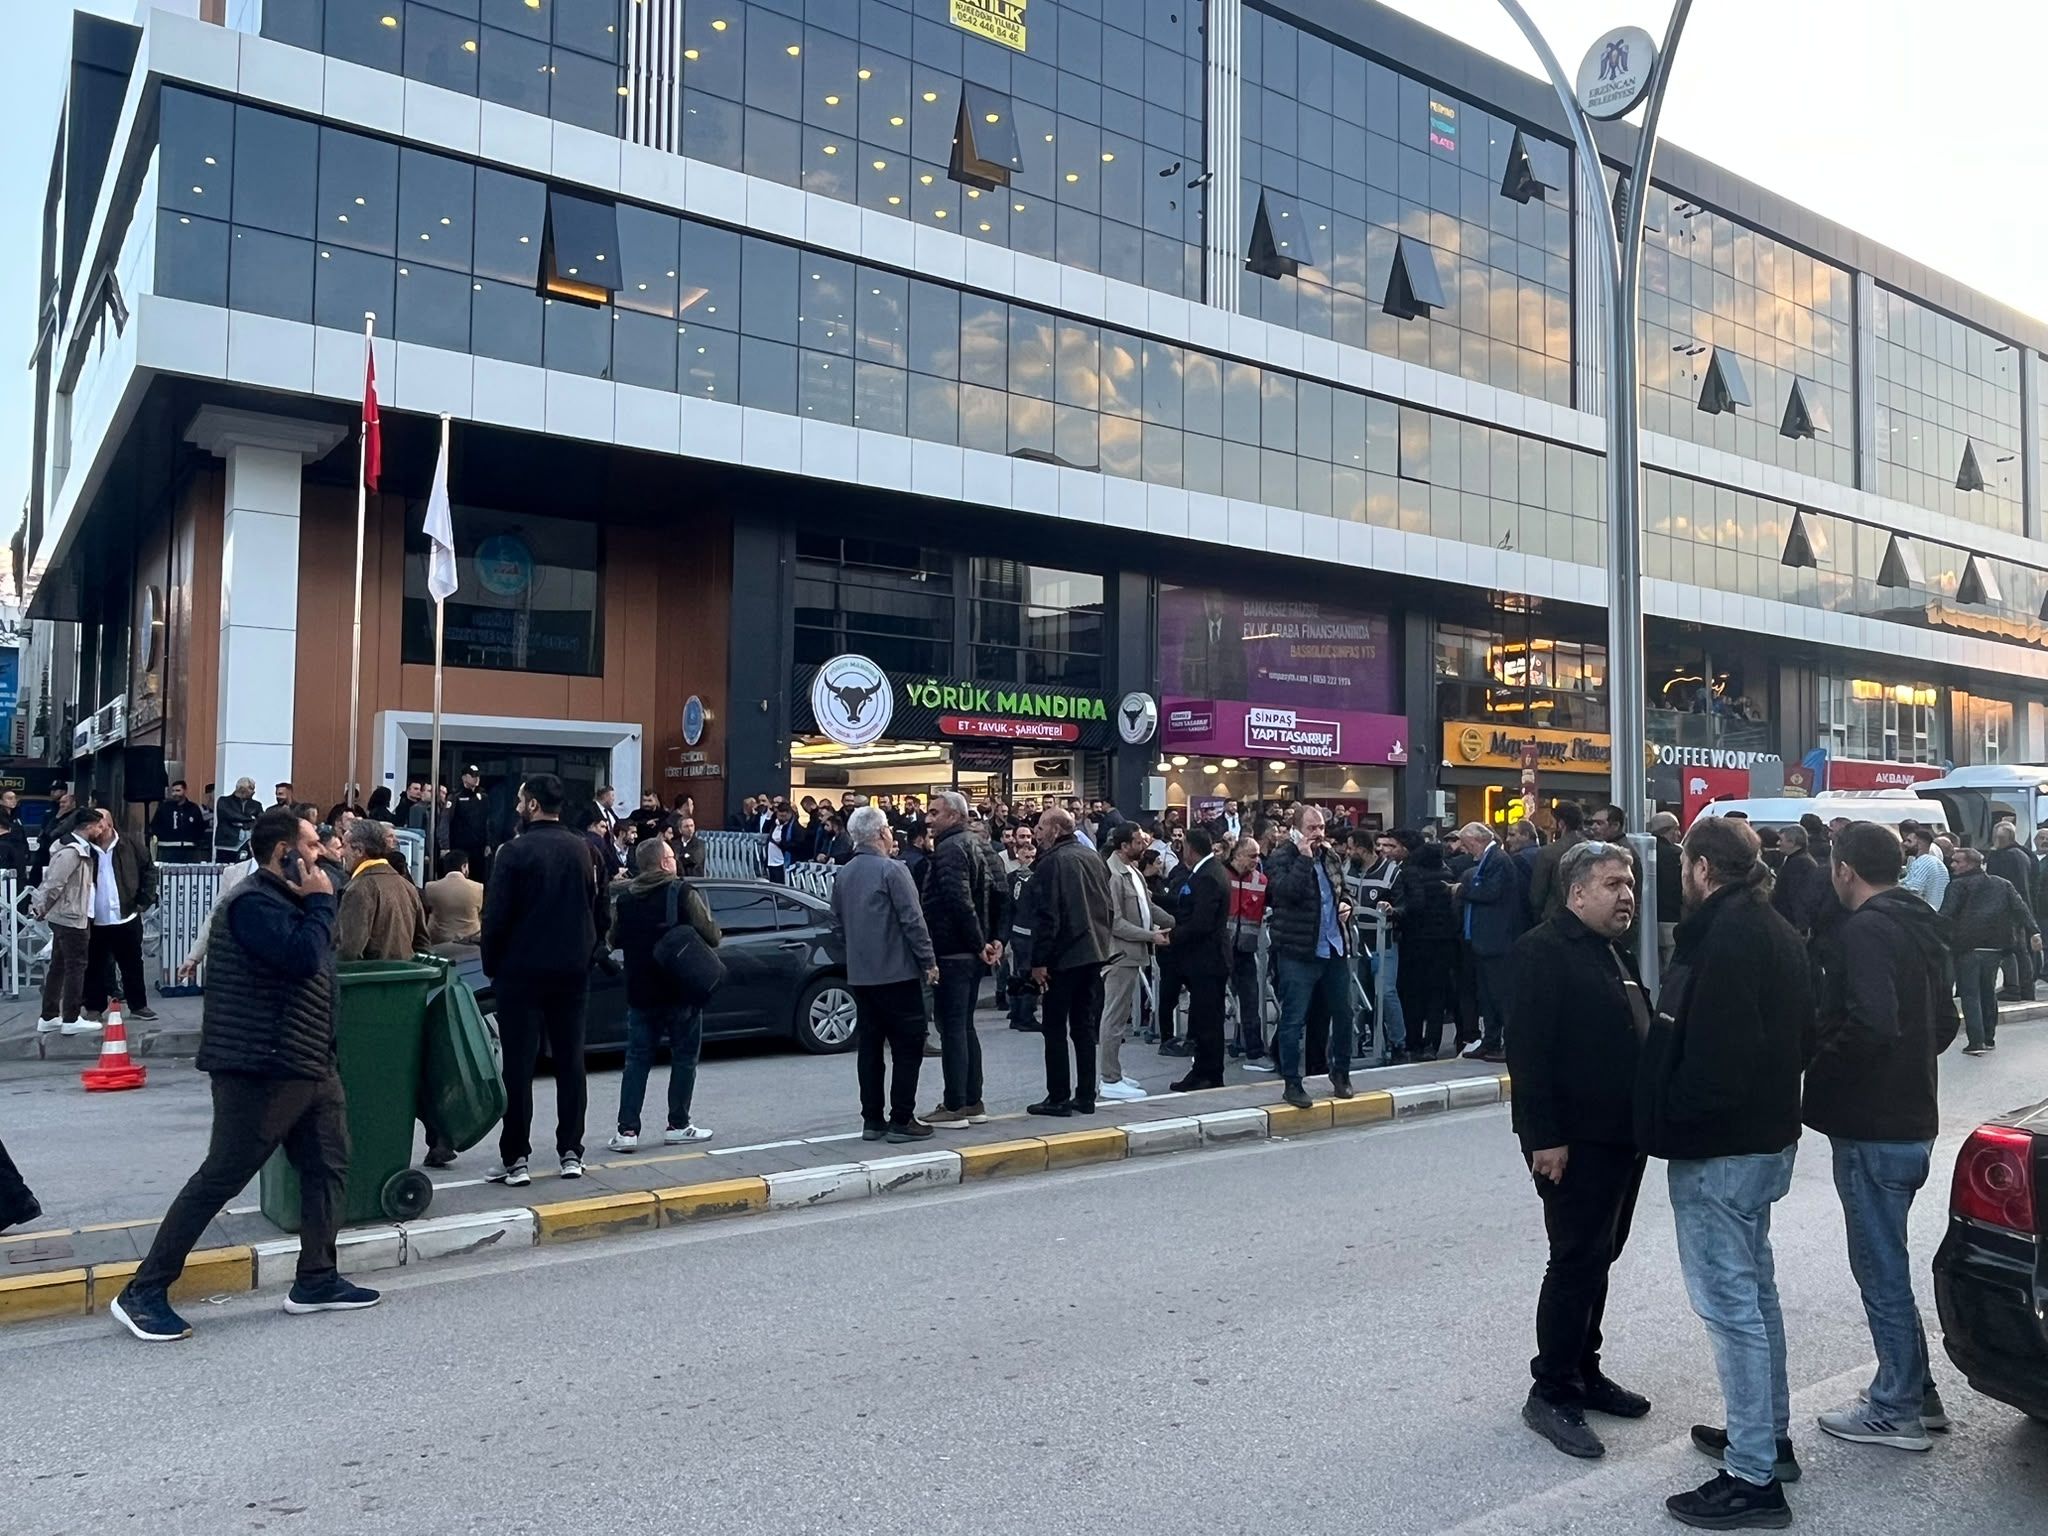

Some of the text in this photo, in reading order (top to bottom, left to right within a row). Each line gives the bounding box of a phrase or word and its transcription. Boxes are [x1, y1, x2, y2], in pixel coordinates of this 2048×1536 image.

[957, 11, 978, 27] 0542
[979, 20, 995, 34] 446
[906, 679, 1108, 721] YÖRÜK MANDIRA
[1255, 711, 1292, 727] SİNPAŞ
[958, 721, 969, 732] ET
[978, 722, 1008, 734] TAVUK
[1251, 727, 1278, 742] YAPI
[1289, 745, 1332, 757] SANDIĞI
[1875, 772, 1915, 785] AKBANK
